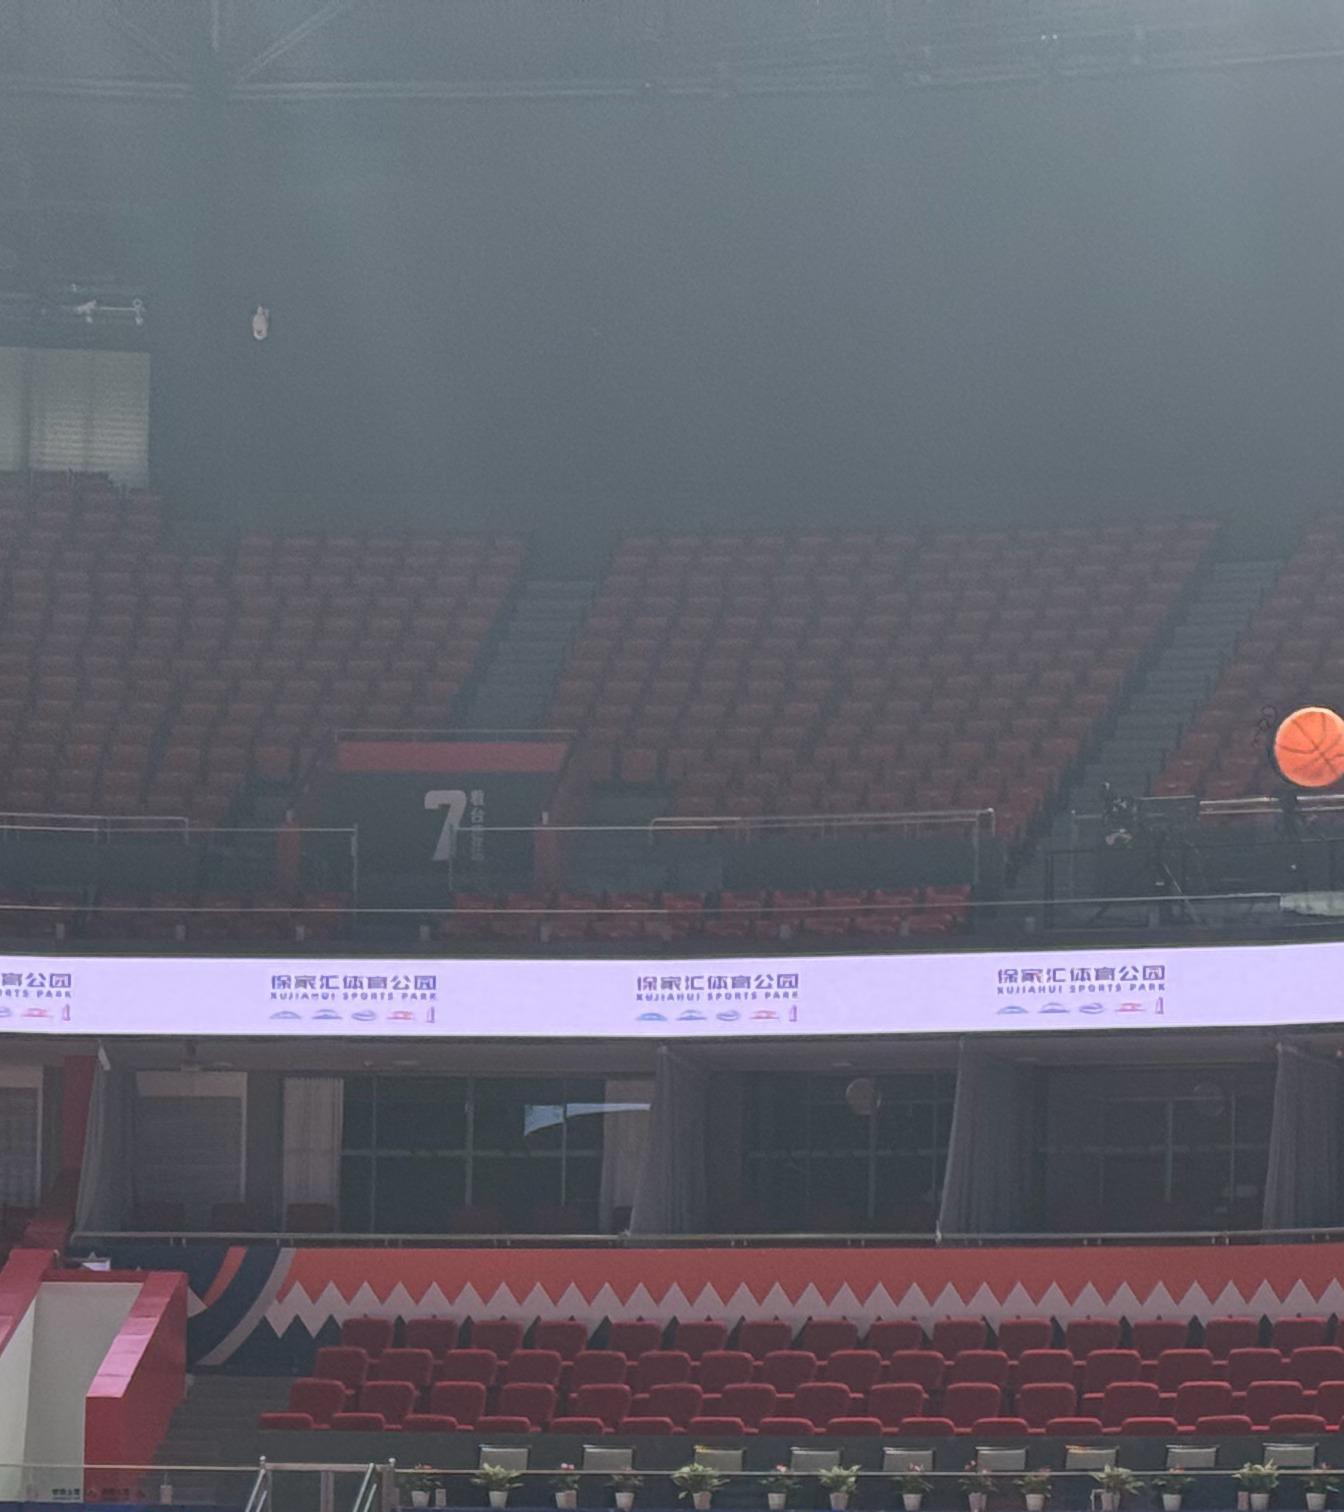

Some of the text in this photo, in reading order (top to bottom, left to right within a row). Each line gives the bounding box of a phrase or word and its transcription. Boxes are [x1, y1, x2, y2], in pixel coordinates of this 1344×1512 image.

[424, 789, 467, 861] 7
[998, 965, 1165, 984] 徐家汇体育公园
[272, 975, 436, 990] 徐家汇体育公园
[637, 974, 799, 991] 徐家汇体育公园
[997, 982, 1165, 994] XUJIAHUI SPORTS PARK
[36, 990, 71, 999] PARK
[271, 992, 437, 1000] XUJIAHUI SPORTS PARK
[636, 990, 798, 1001] XUJIAHUI SPORTS PARK
